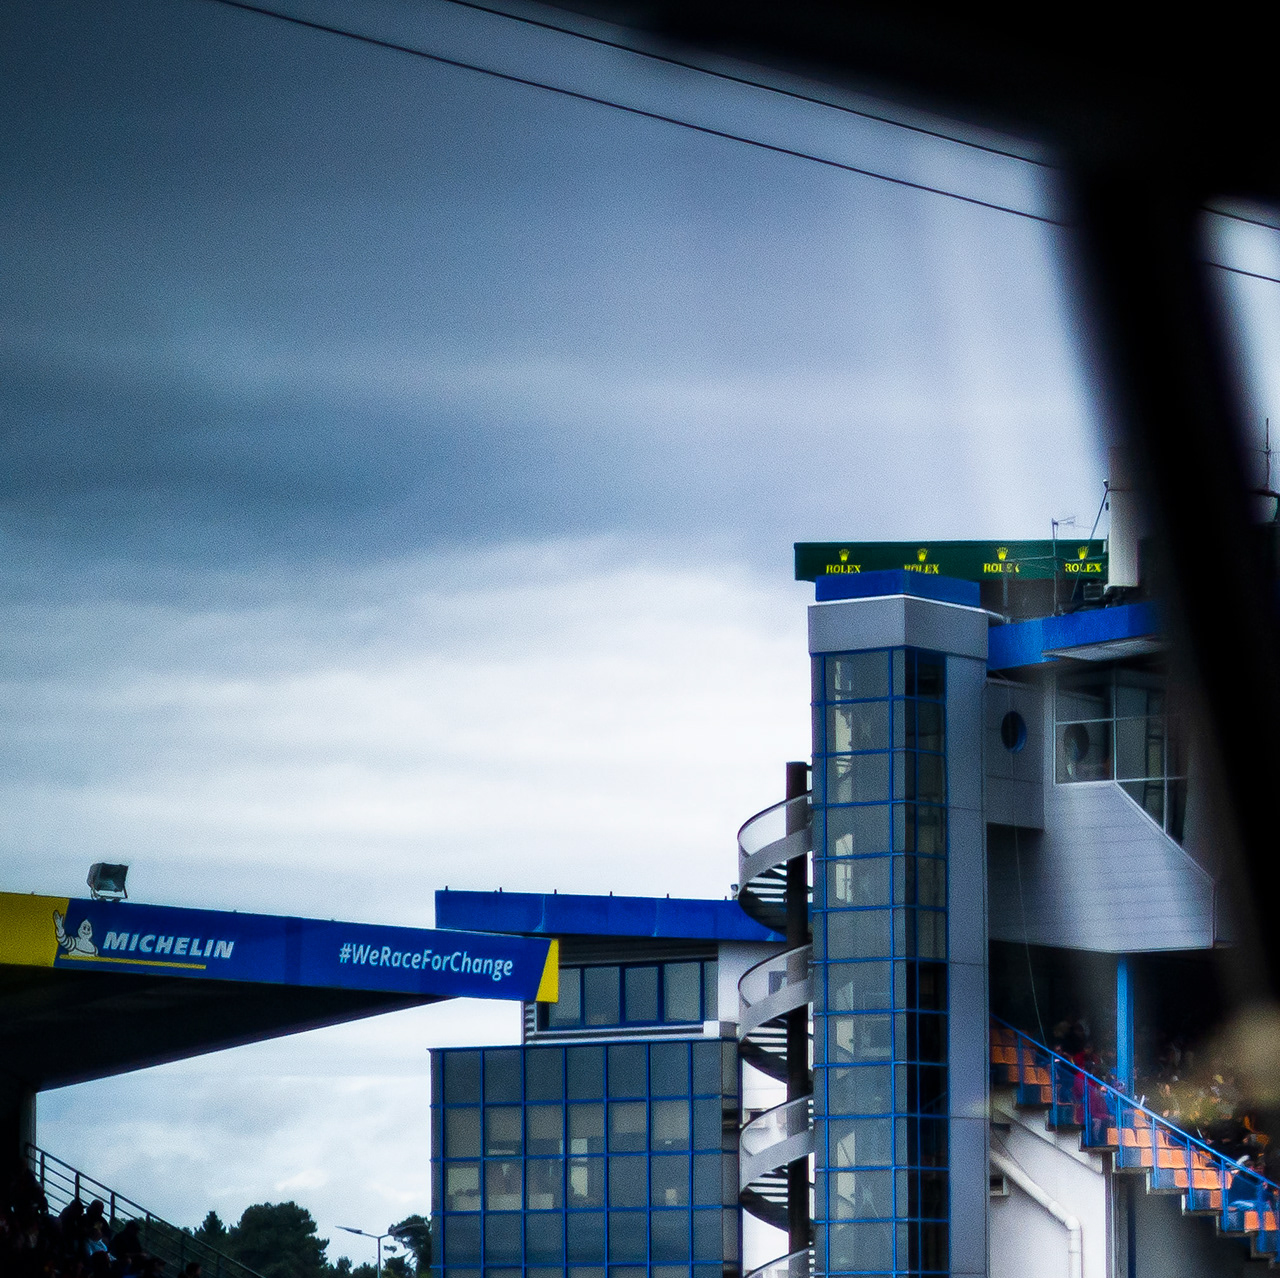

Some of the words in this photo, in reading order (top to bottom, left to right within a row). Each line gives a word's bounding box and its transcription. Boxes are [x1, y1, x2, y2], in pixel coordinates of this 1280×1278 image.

[826, 565, 861, 574] ROLEX
[102, 930, 234, 960] MICHELIN
[339, 942, 513, 981] #WeRaceForChange
